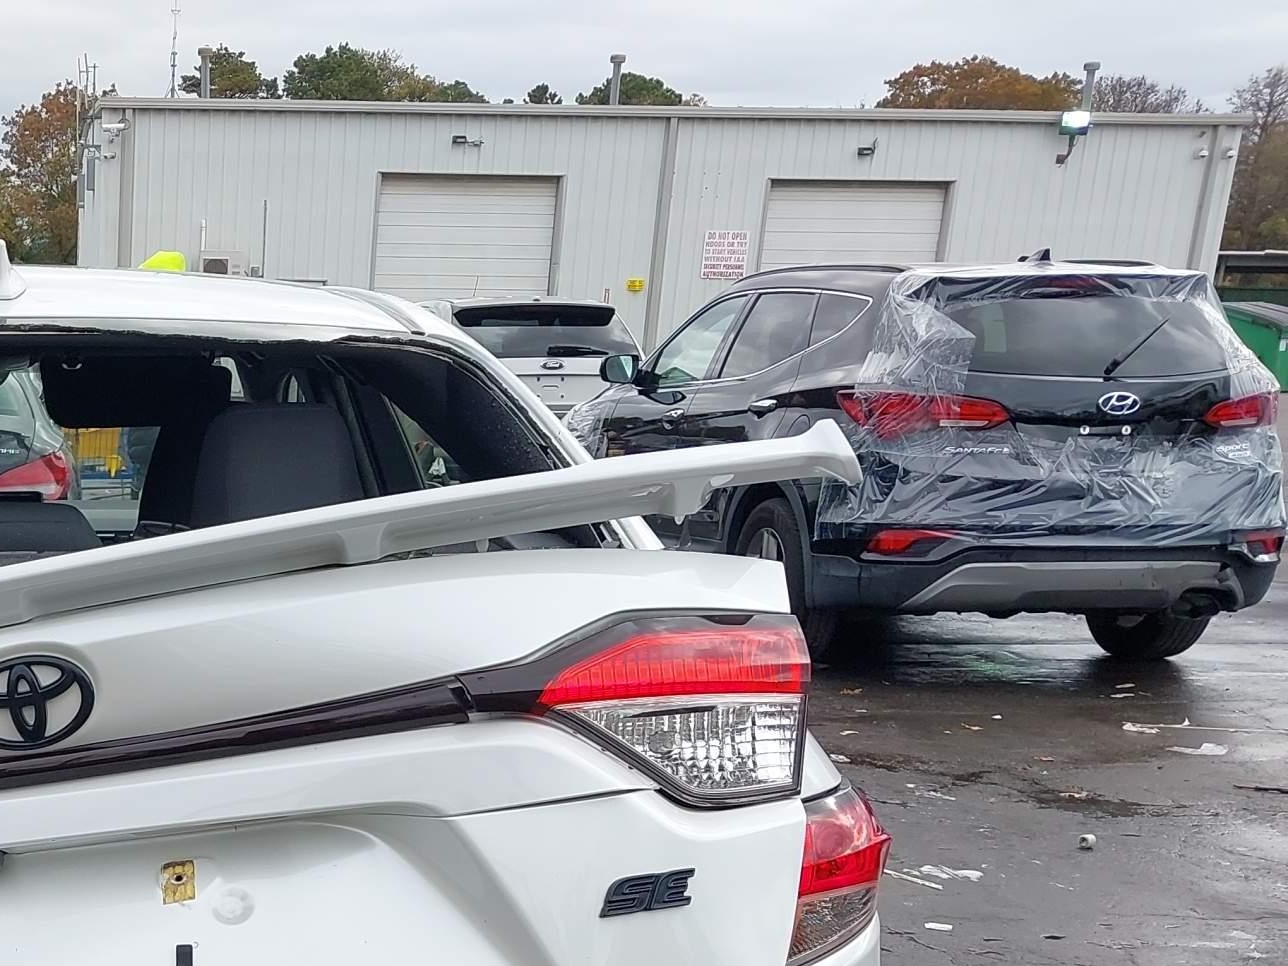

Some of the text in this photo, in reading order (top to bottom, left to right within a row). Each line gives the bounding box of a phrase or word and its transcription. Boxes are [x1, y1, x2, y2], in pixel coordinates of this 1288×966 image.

[708, 232, 747, 240] DO NOT OPEN
[599, 867, 695, 918] SE
